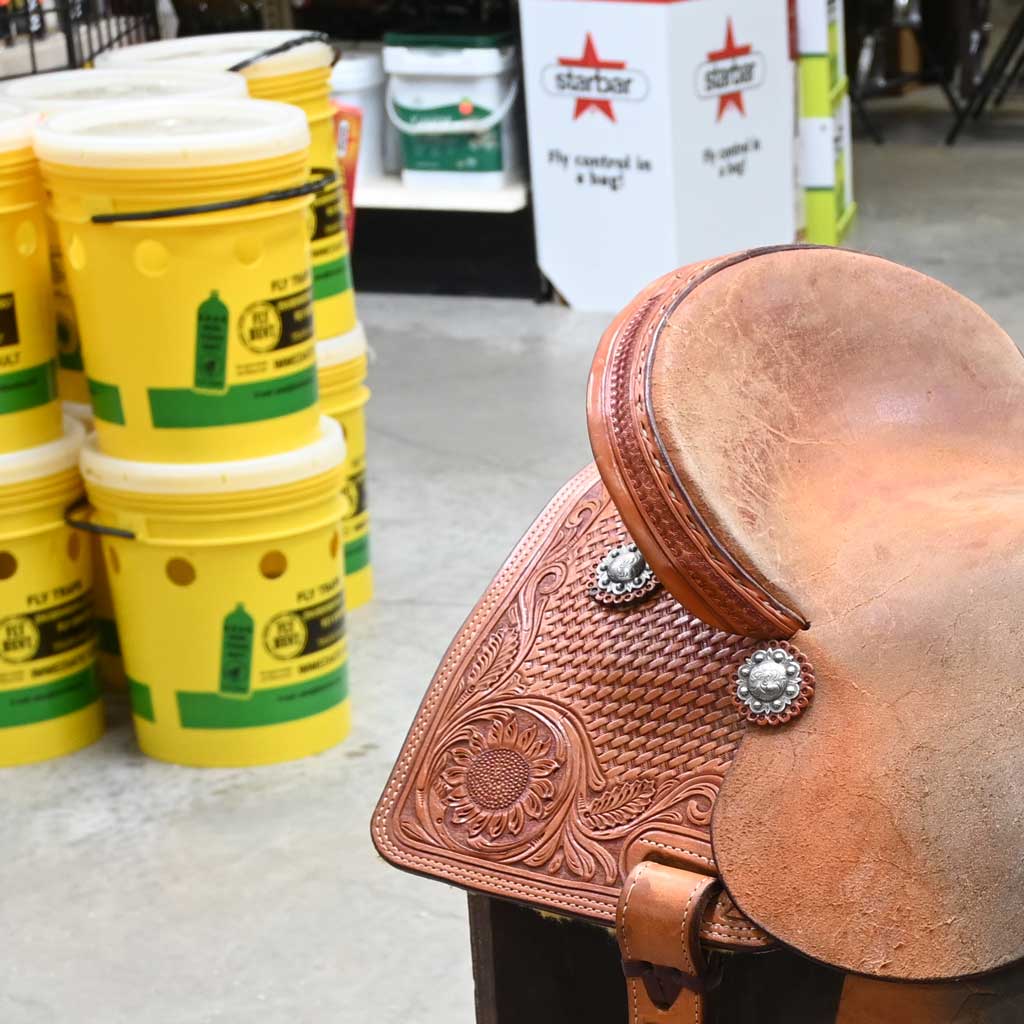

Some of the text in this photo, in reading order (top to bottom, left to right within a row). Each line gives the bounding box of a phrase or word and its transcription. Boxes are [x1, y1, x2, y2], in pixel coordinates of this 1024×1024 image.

[555, 67, 632, 95] starbar
[705, 58, 755, 91] starbar
[548, 148, 652, 172] Fly control in
